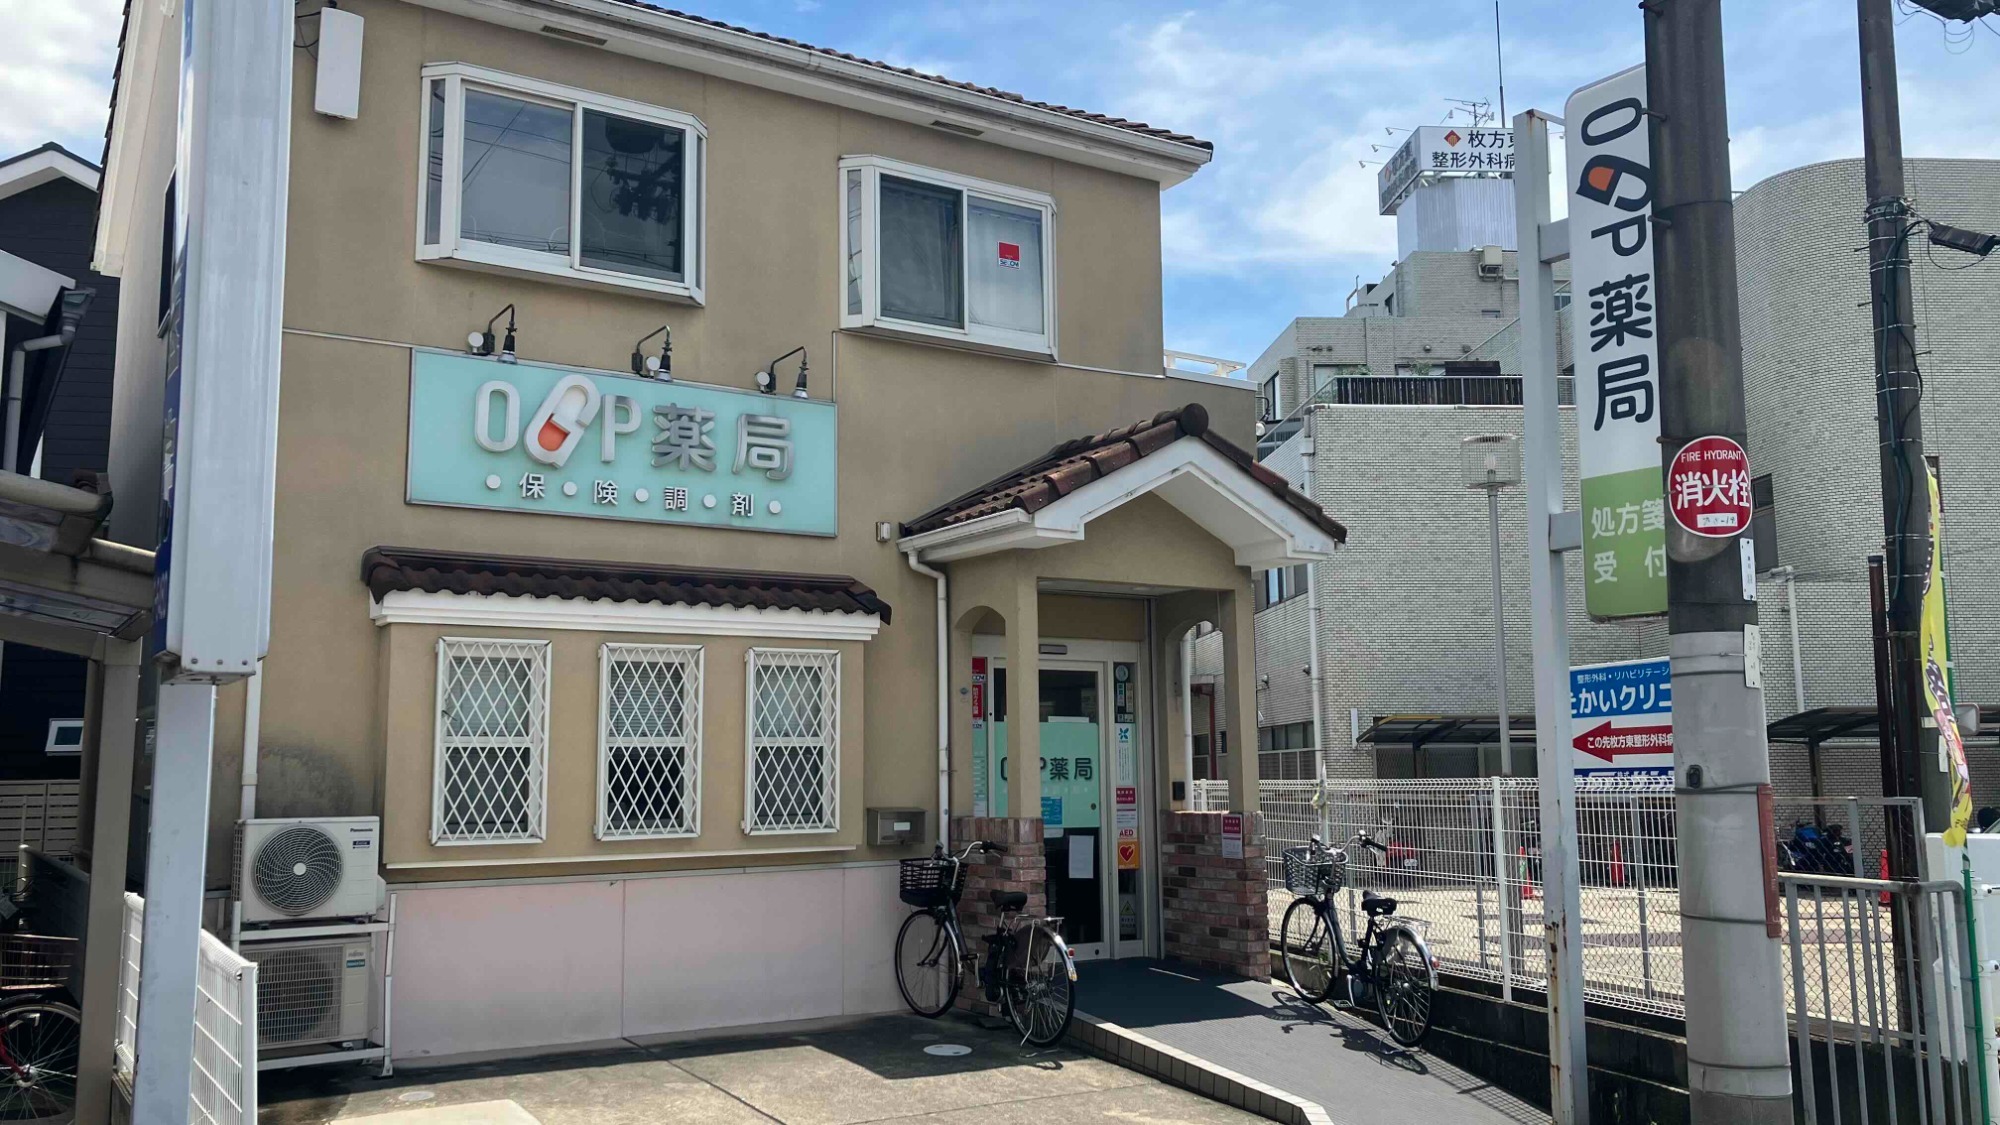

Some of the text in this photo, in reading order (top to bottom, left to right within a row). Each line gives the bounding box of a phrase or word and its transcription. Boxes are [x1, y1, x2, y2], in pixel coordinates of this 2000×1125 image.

[1681, 450, 1742, 463] FIRE HYDRANT
[1674, 468, 1750, 510] 消火栓
[1591, 498, 1665, 539] 処方箋
[1119, 829, 1134, 837] AED
